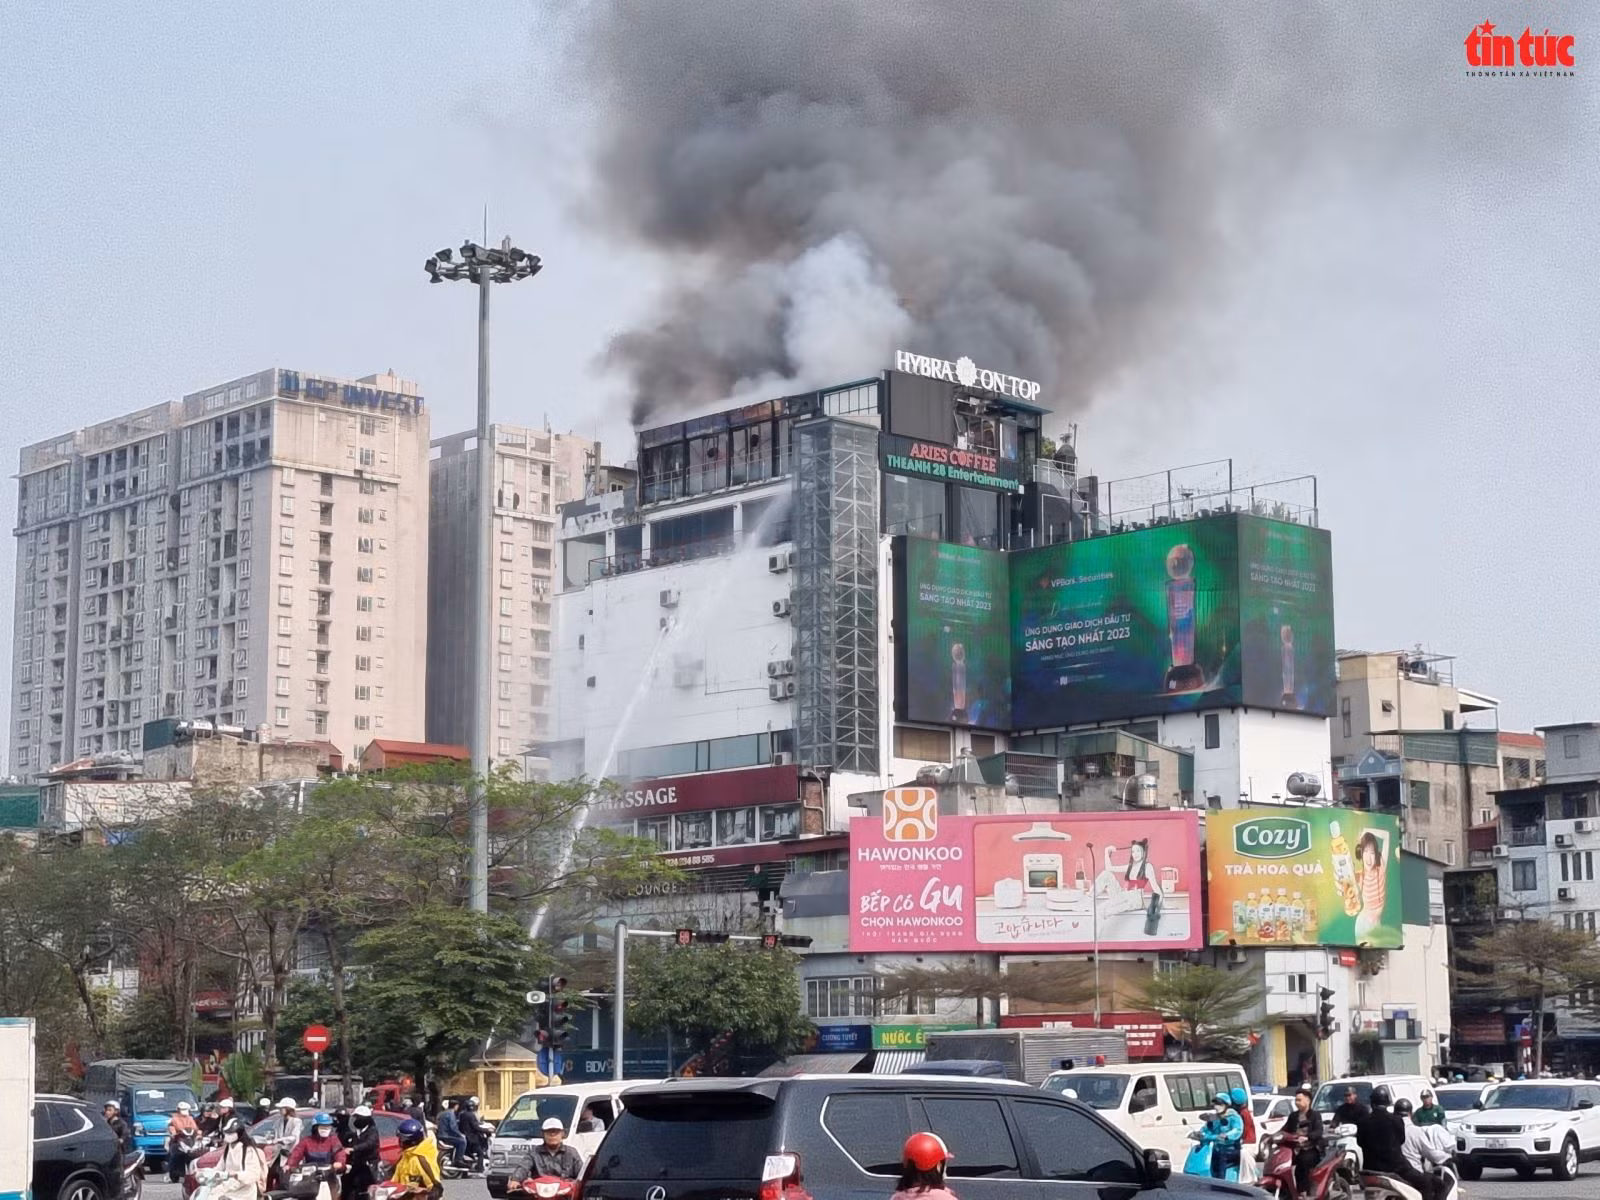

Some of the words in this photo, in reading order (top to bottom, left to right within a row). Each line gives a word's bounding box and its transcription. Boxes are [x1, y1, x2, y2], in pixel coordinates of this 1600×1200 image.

[896, 350, 954, 383] HYBRA
[980, 369, 1005, 394] ON
[1008, 375, 1041, 401] TOP
[910, 443, 948, 463] ARIES
[950, 450, 997, 473] COFFEE
[887, 454, 931, 475] THEANH
[933, 463, 947, 477] 28
[948, 466, 1020, 490] Entertainment
[1064, 620, 1084, 631] GIAO
[1025, 637, 1054, 652] SÁNG
[1055, 635, 1076, 650] TẠO
[1107, 627, 1131, 641] 2023
[1242, 825, 1301, 849] Cozy
[858, 847, 963, 862] HAWONKOO
[1224, 862, 1253, 875] TRÀ
[1257, 864, 1288, 875] HOA
[1292, 859, 1323, 877] QUẢ
[860, 889, 890, 914] BẾP
[860, 916, 894, 929] CHỌN
[896, 916, 963, 927] HAWONKOO
[881, 1029, 912, 1045] NƯỚC
